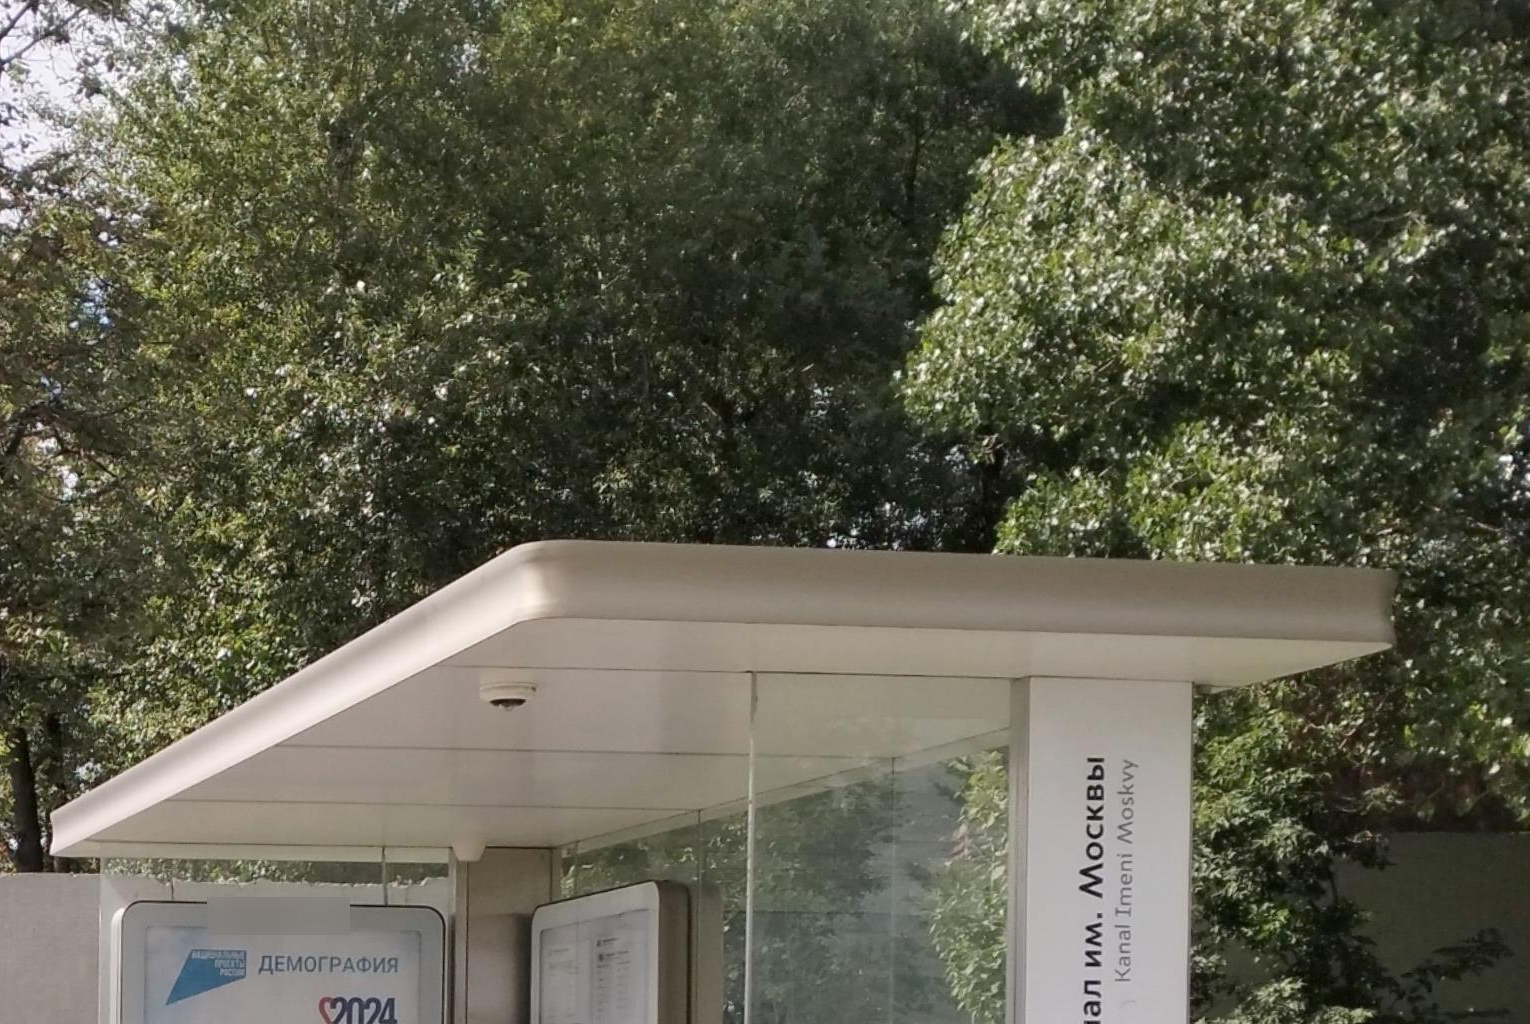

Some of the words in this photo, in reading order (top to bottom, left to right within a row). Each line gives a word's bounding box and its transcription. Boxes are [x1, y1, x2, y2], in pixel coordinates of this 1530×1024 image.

[1078, 757, 1105, 899] Москвы
[1116, 760, 1139, 844] Moskvy
[1115, 853, 1133, 917] Imeni
[258, 955, 399, 975] ДЕМОГРАФИЯ
[1084, 912, 1103, 968] им.
[1114, 925, 1132, 982] Kanal
